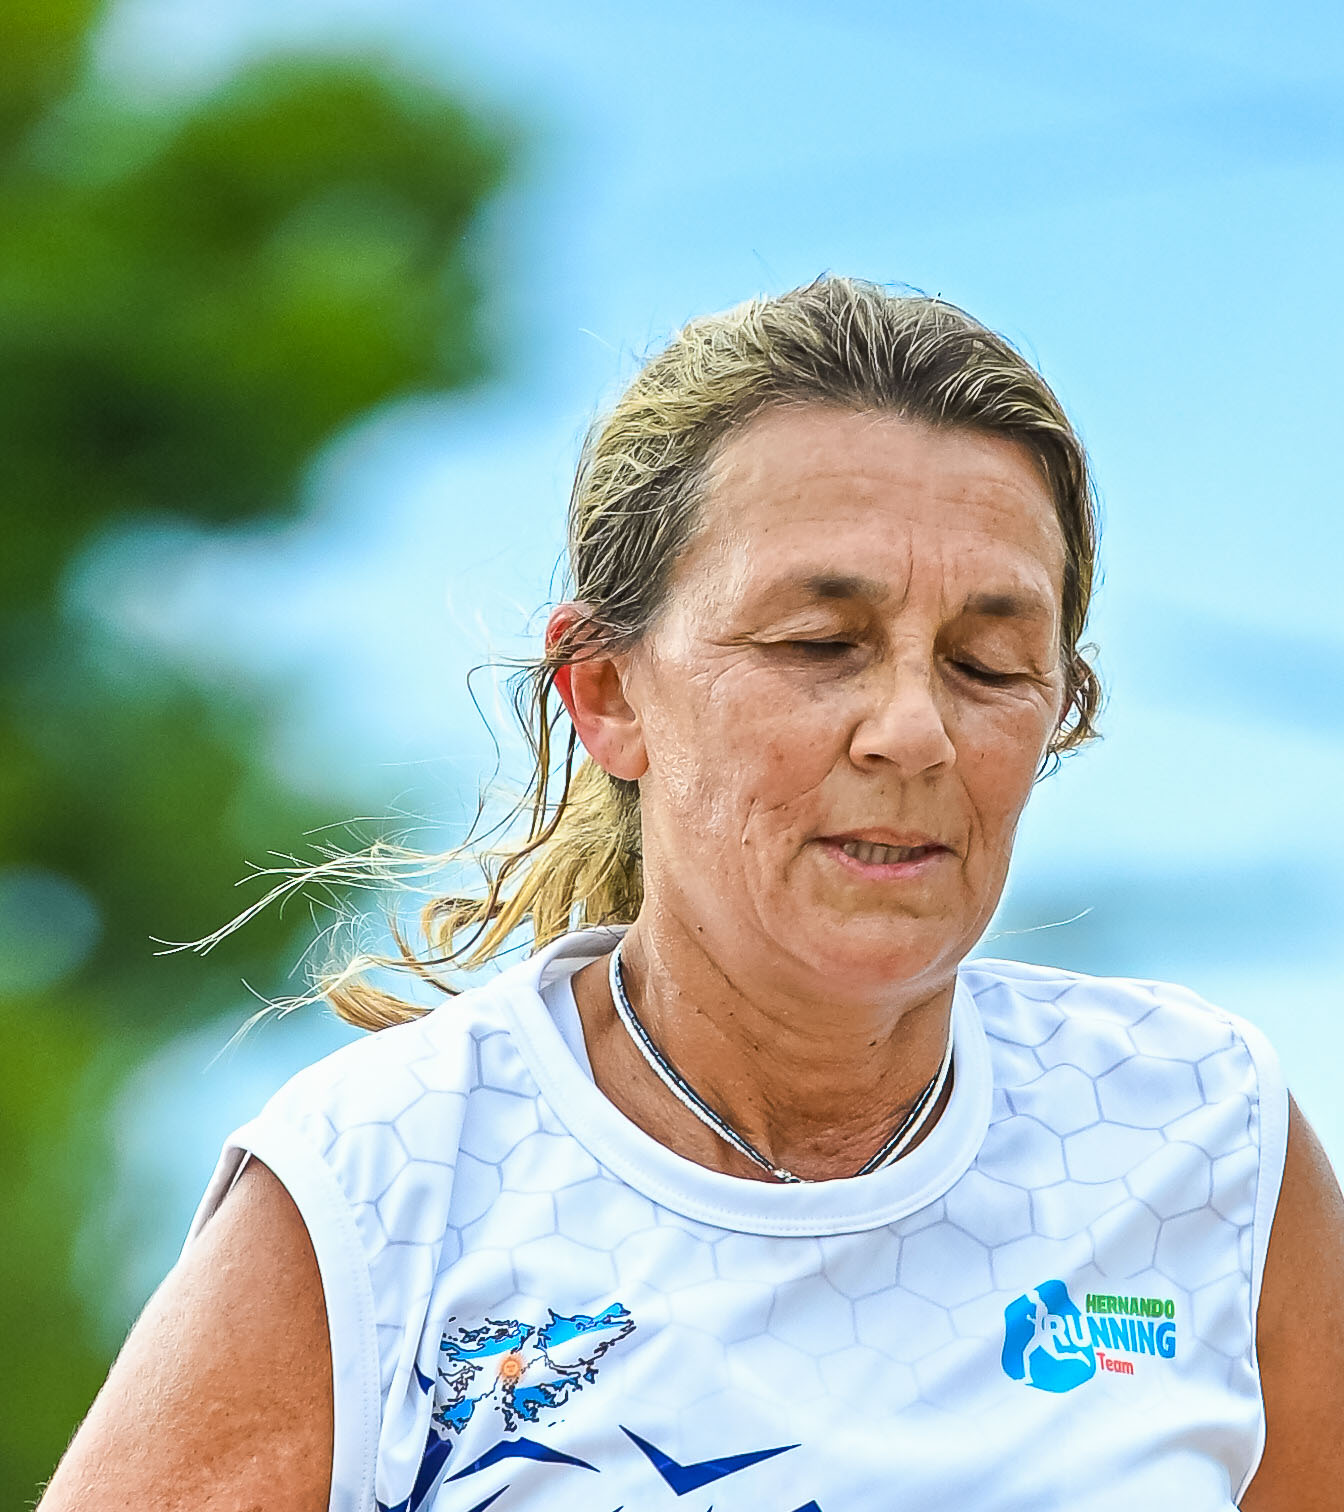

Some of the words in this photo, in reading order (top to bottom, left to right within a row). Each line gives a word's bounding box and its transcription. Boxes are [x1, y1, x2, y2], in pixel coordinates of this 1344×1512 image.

[1086, 1293, 1176, 1319] HERNANDO
[1047, 1313, 1177, 1359] RUNNING
[1096, 1352, 1135, 1376] Team
